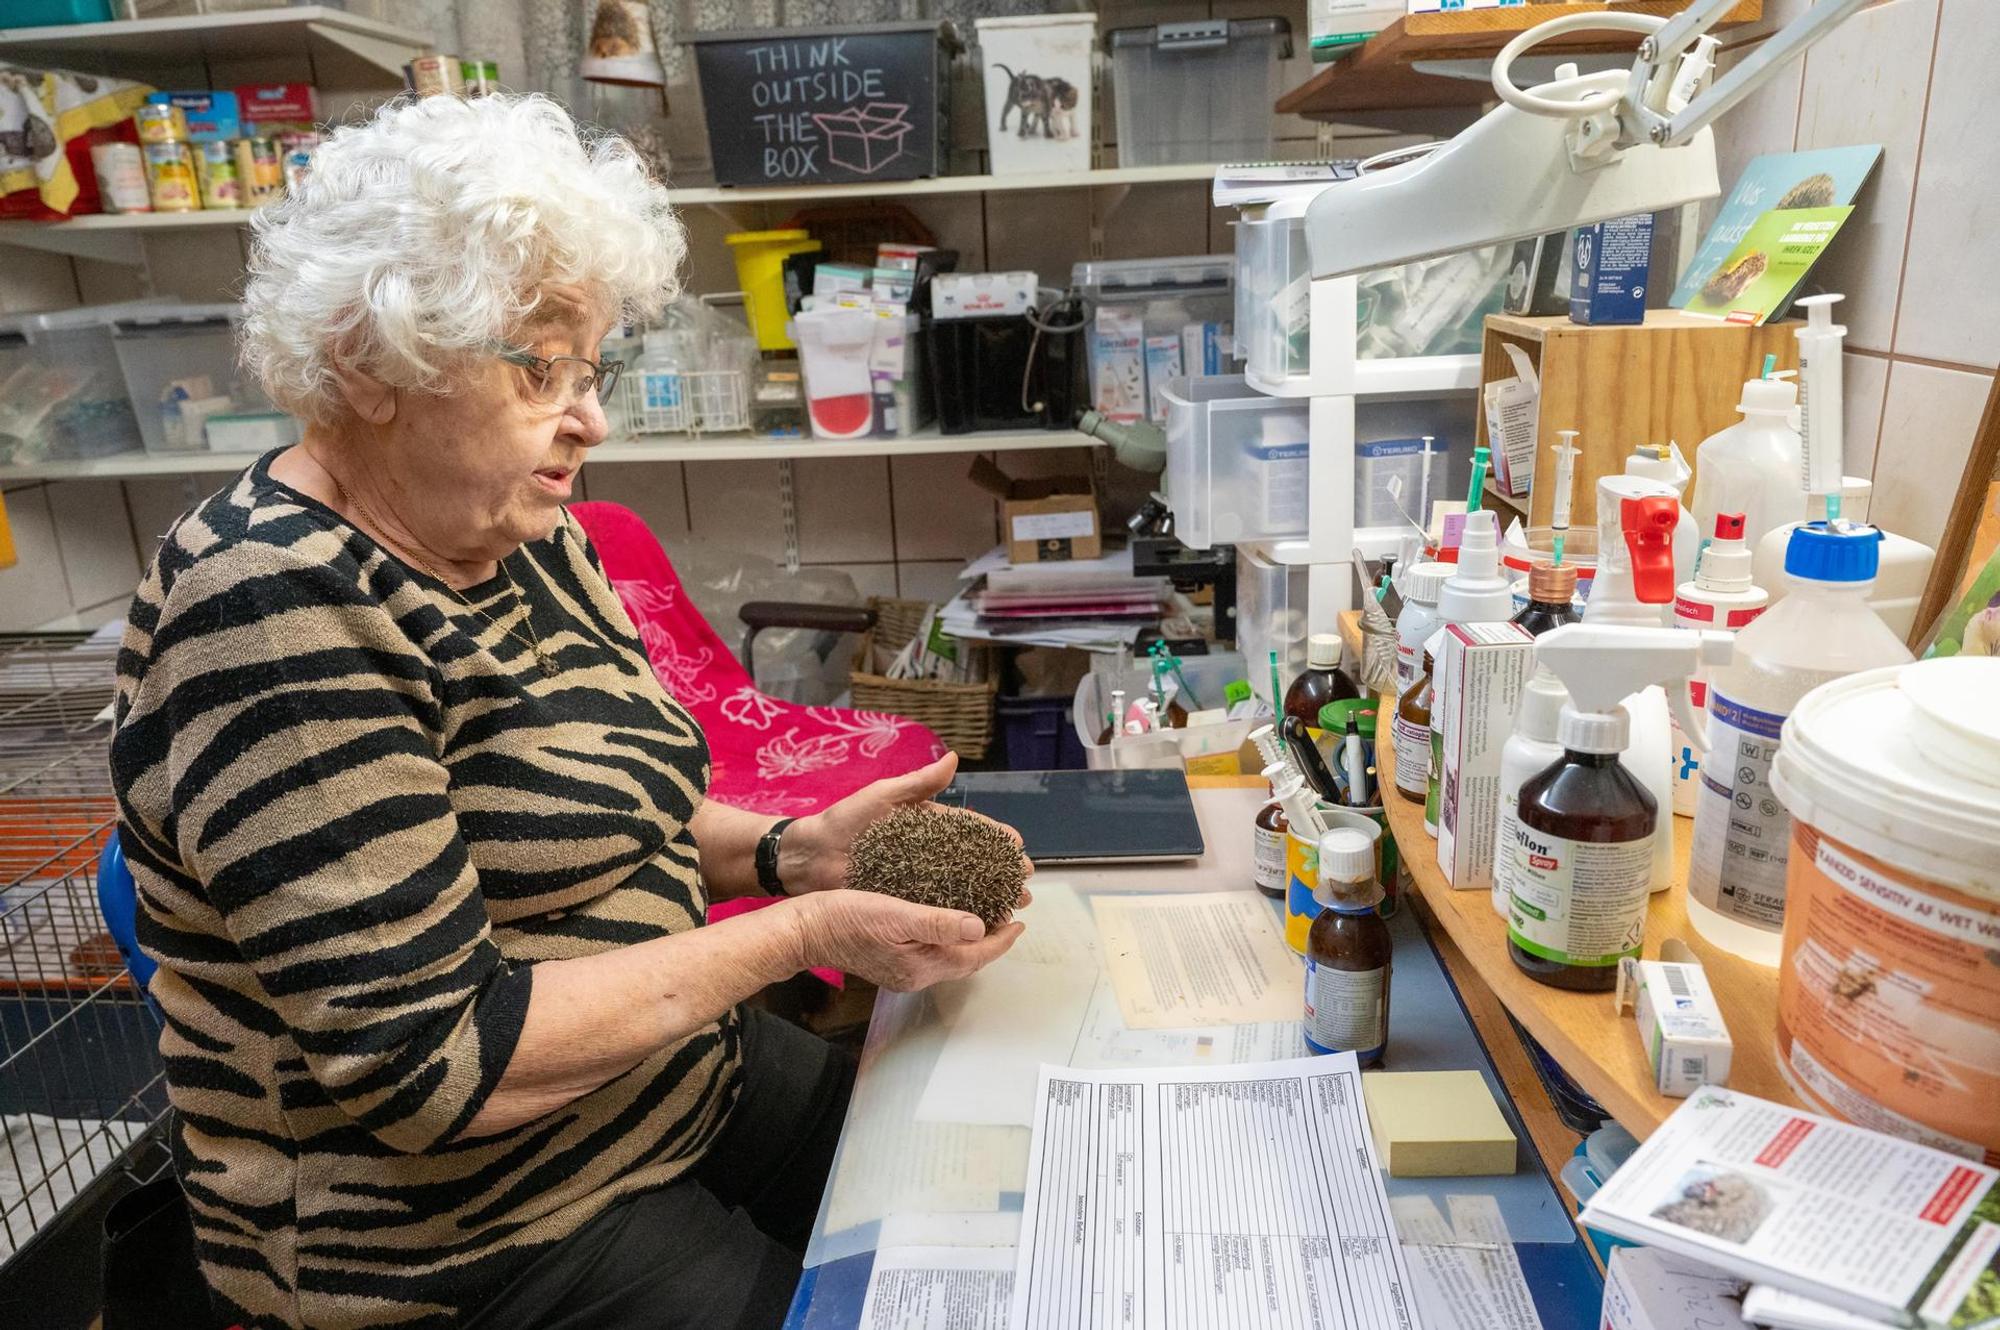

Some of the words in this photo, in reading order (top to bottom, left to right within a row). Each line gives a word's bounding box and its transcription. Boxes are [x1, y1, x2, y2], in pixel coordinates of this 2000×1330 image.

[747, 37, 849, 74] THINK
[753, 69, 885, 107] OUTSIDE
[754, 112, 818, 142] THE
[764, 145, 819, 177] BOX
[1531, 856, 1556, 869] Spray
[1860, 875, 1913, 908] SENSITIV
[1939, 910, 1973, 929] WET
[1390, 1282, 1404, 1307] Angaben
[1397, 1308, 1406, 1321] zum
